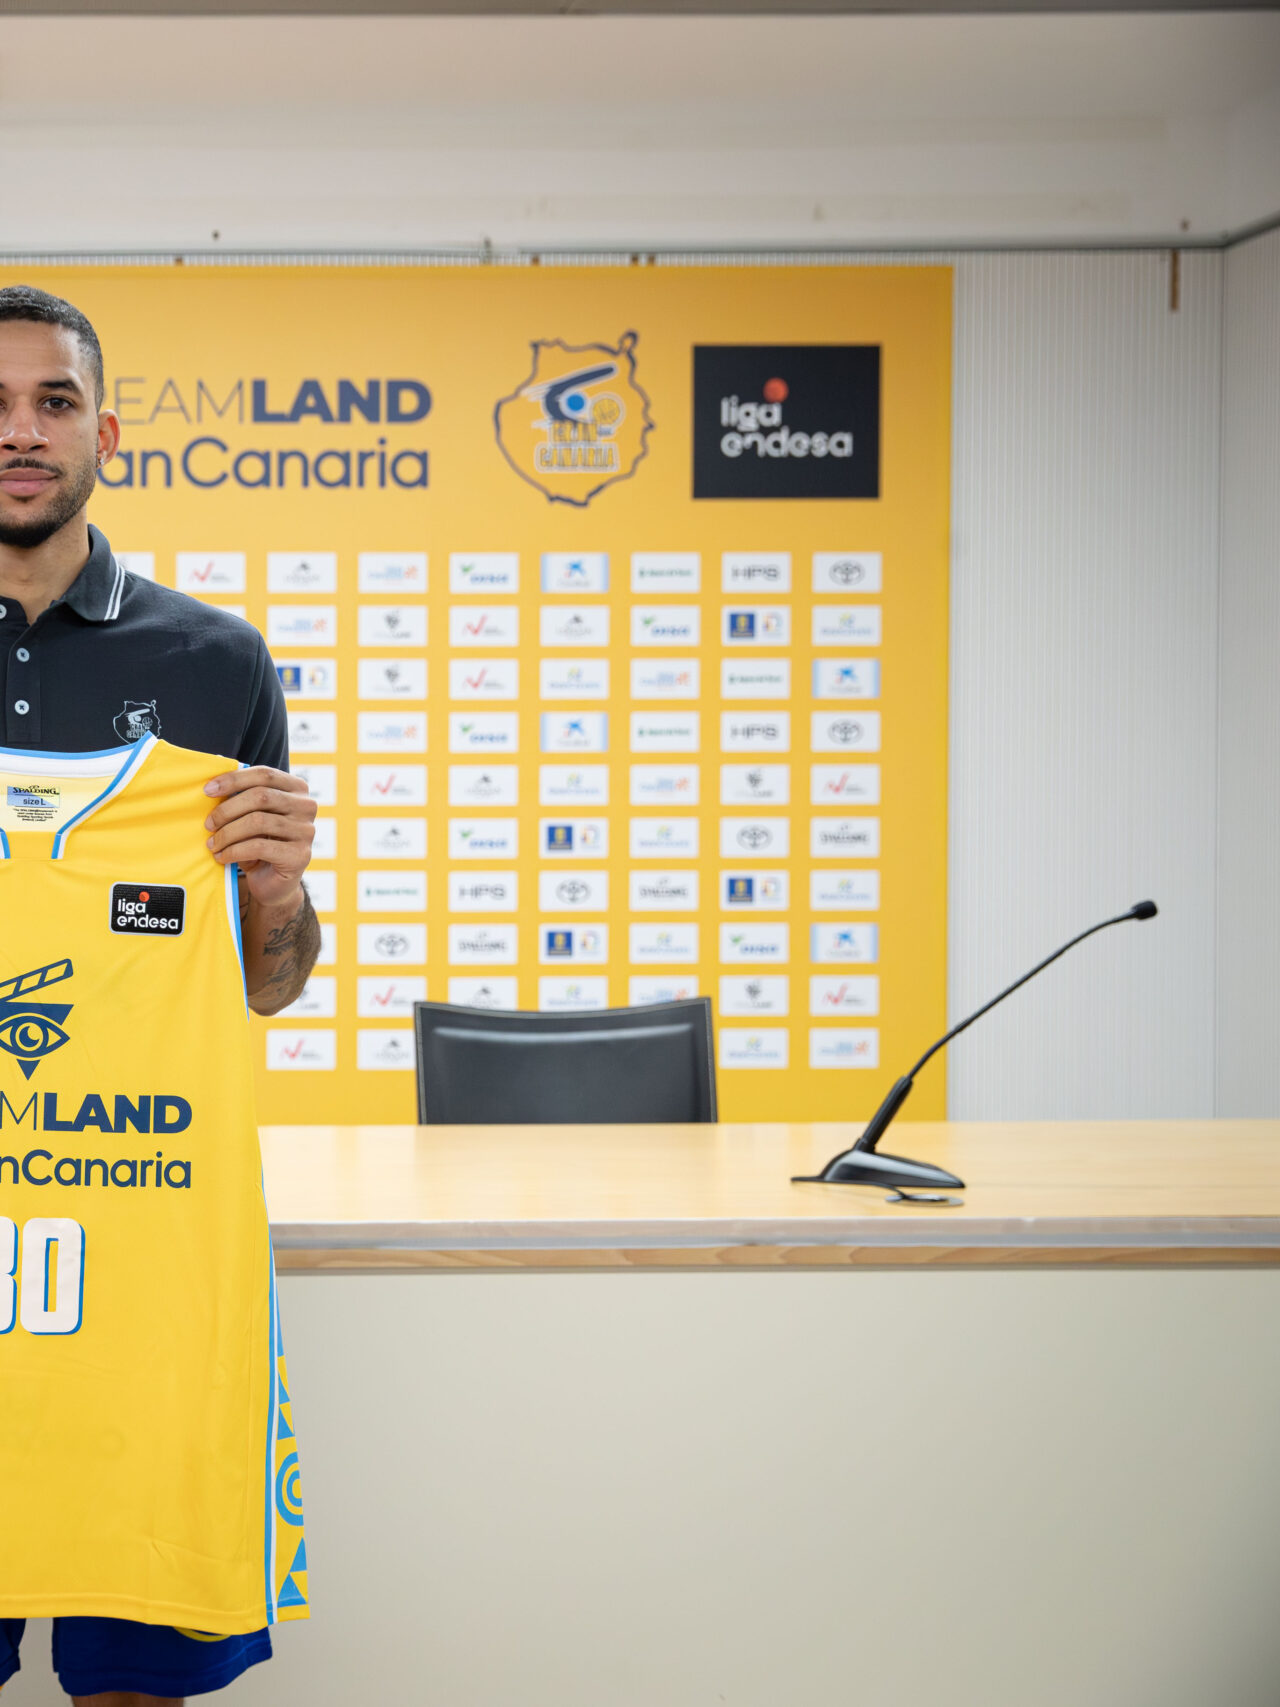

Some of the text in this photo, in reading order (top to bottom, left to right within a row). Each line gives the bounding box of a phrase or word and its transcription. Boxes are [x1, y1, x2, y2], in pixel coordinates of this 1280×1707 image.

[102, 376, 433, 425] EAMLAND
[721, 396, 782, 430] liga
[720, 427, 853, 458] endesa
[97, 436, 428, 489] anCanaria
[13, 785, 60, 795] SPALDING
[116, 914, 179, 930] endesa
[117, 898, 146, 915] liga
